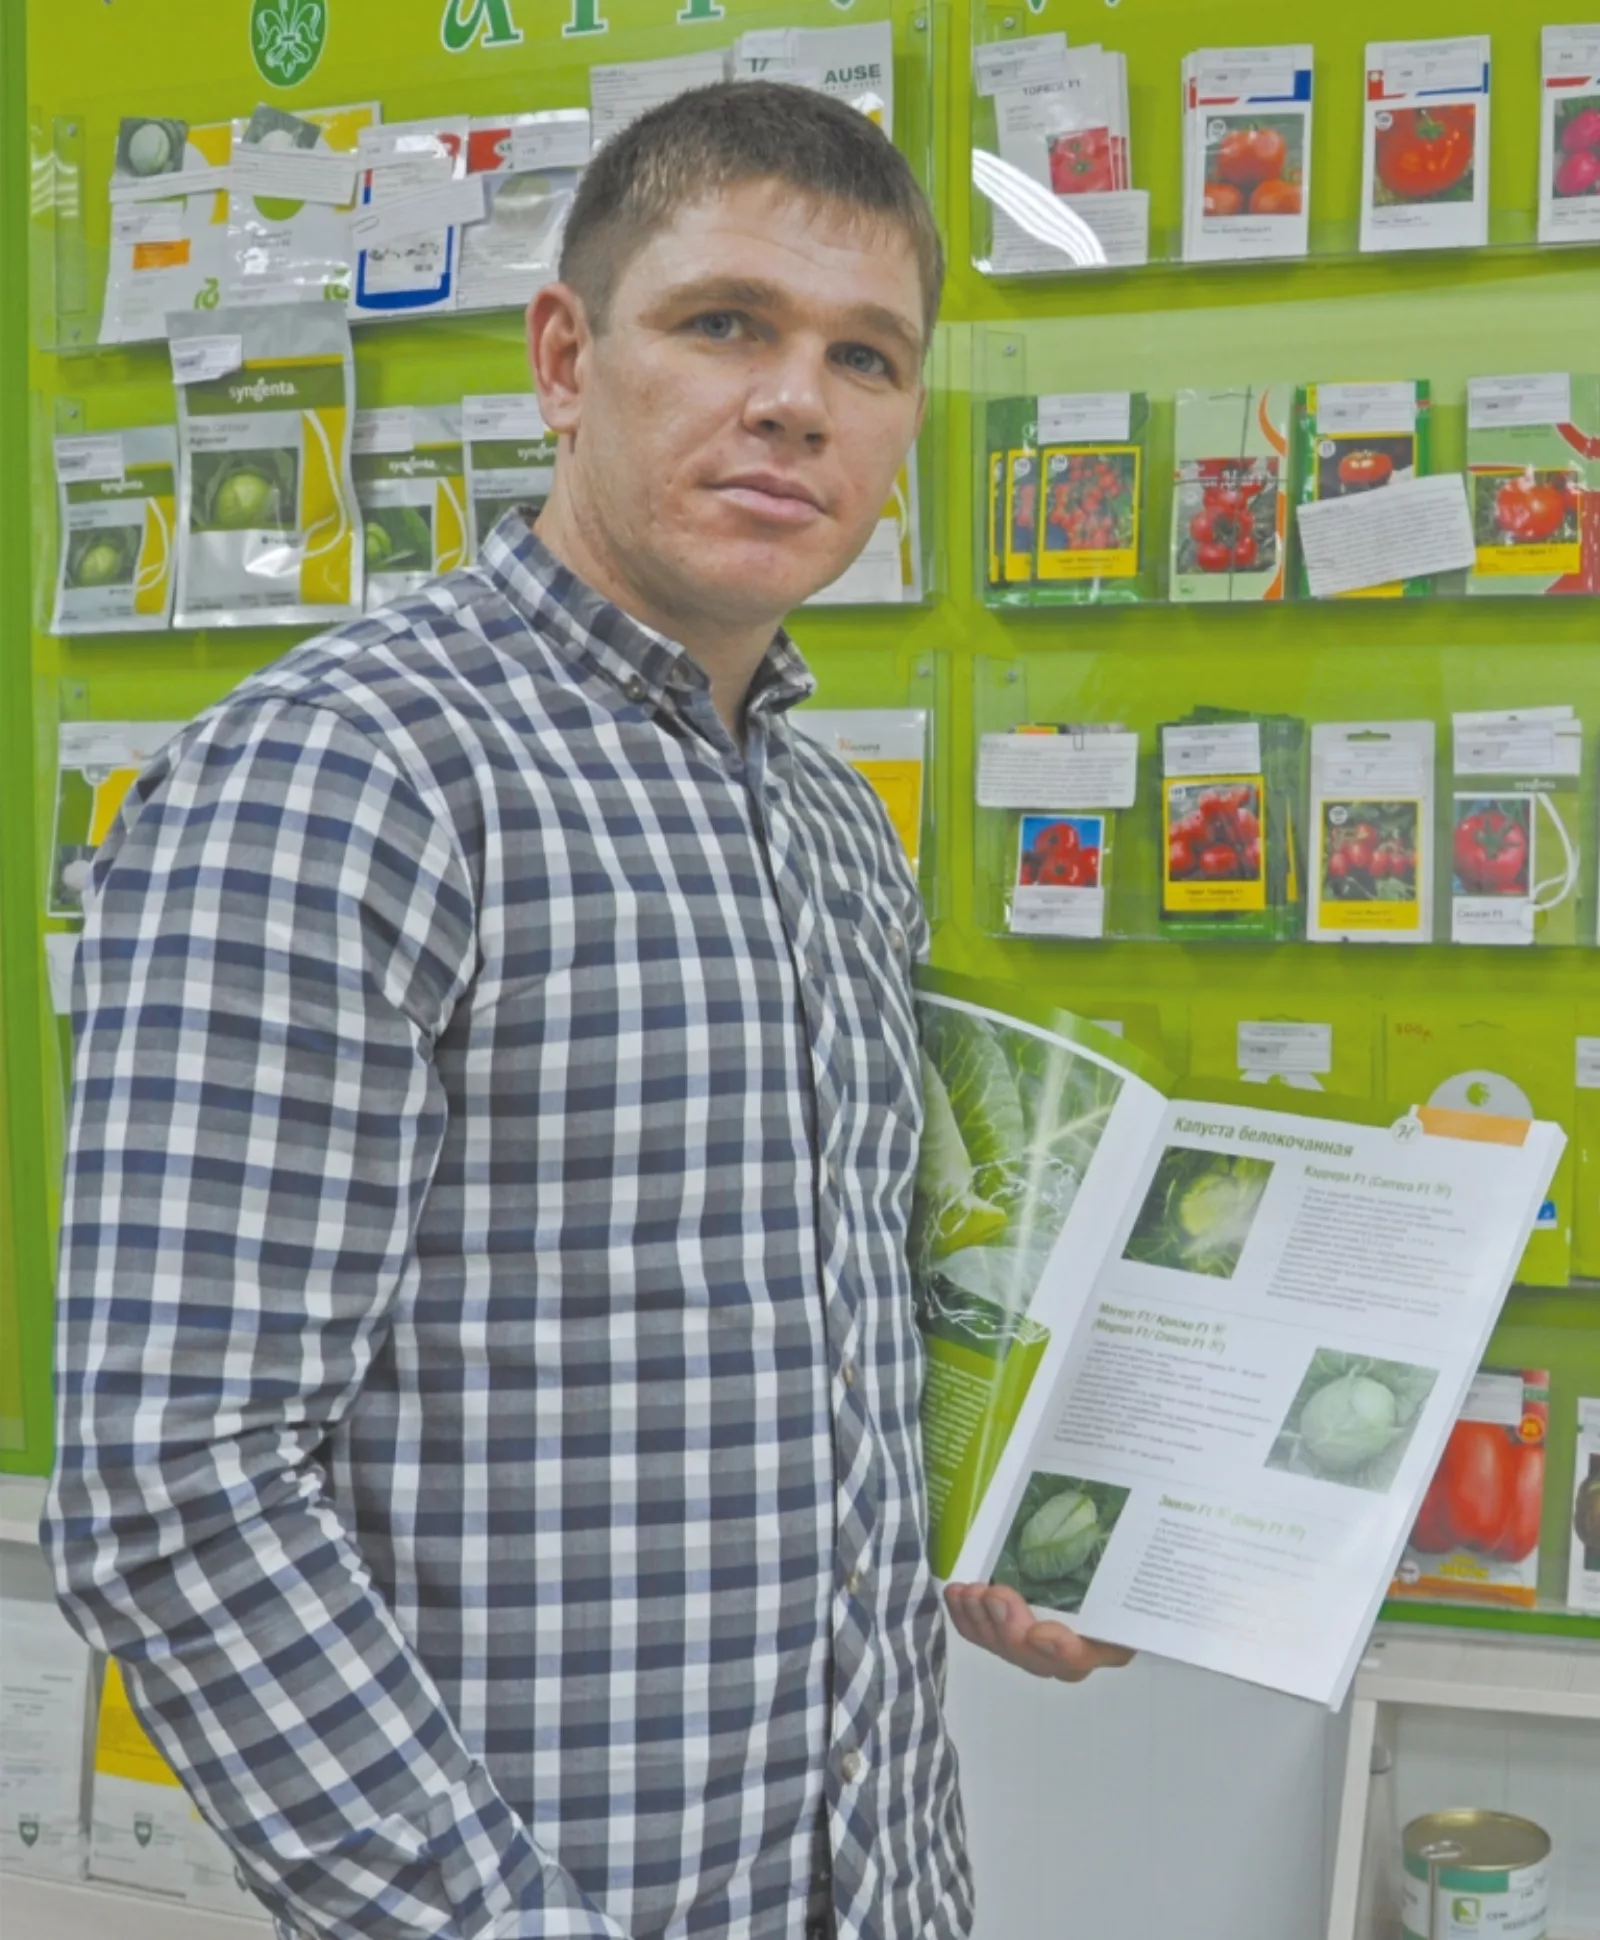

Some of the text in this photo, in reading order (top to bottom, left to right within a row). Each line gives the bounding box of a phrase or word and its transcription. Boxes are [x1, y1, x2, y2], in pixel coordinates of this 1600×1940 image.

[228, 377, 297, 404] syngenta
[1173, 1116, 1355, 1158] Капуста белокочанная
